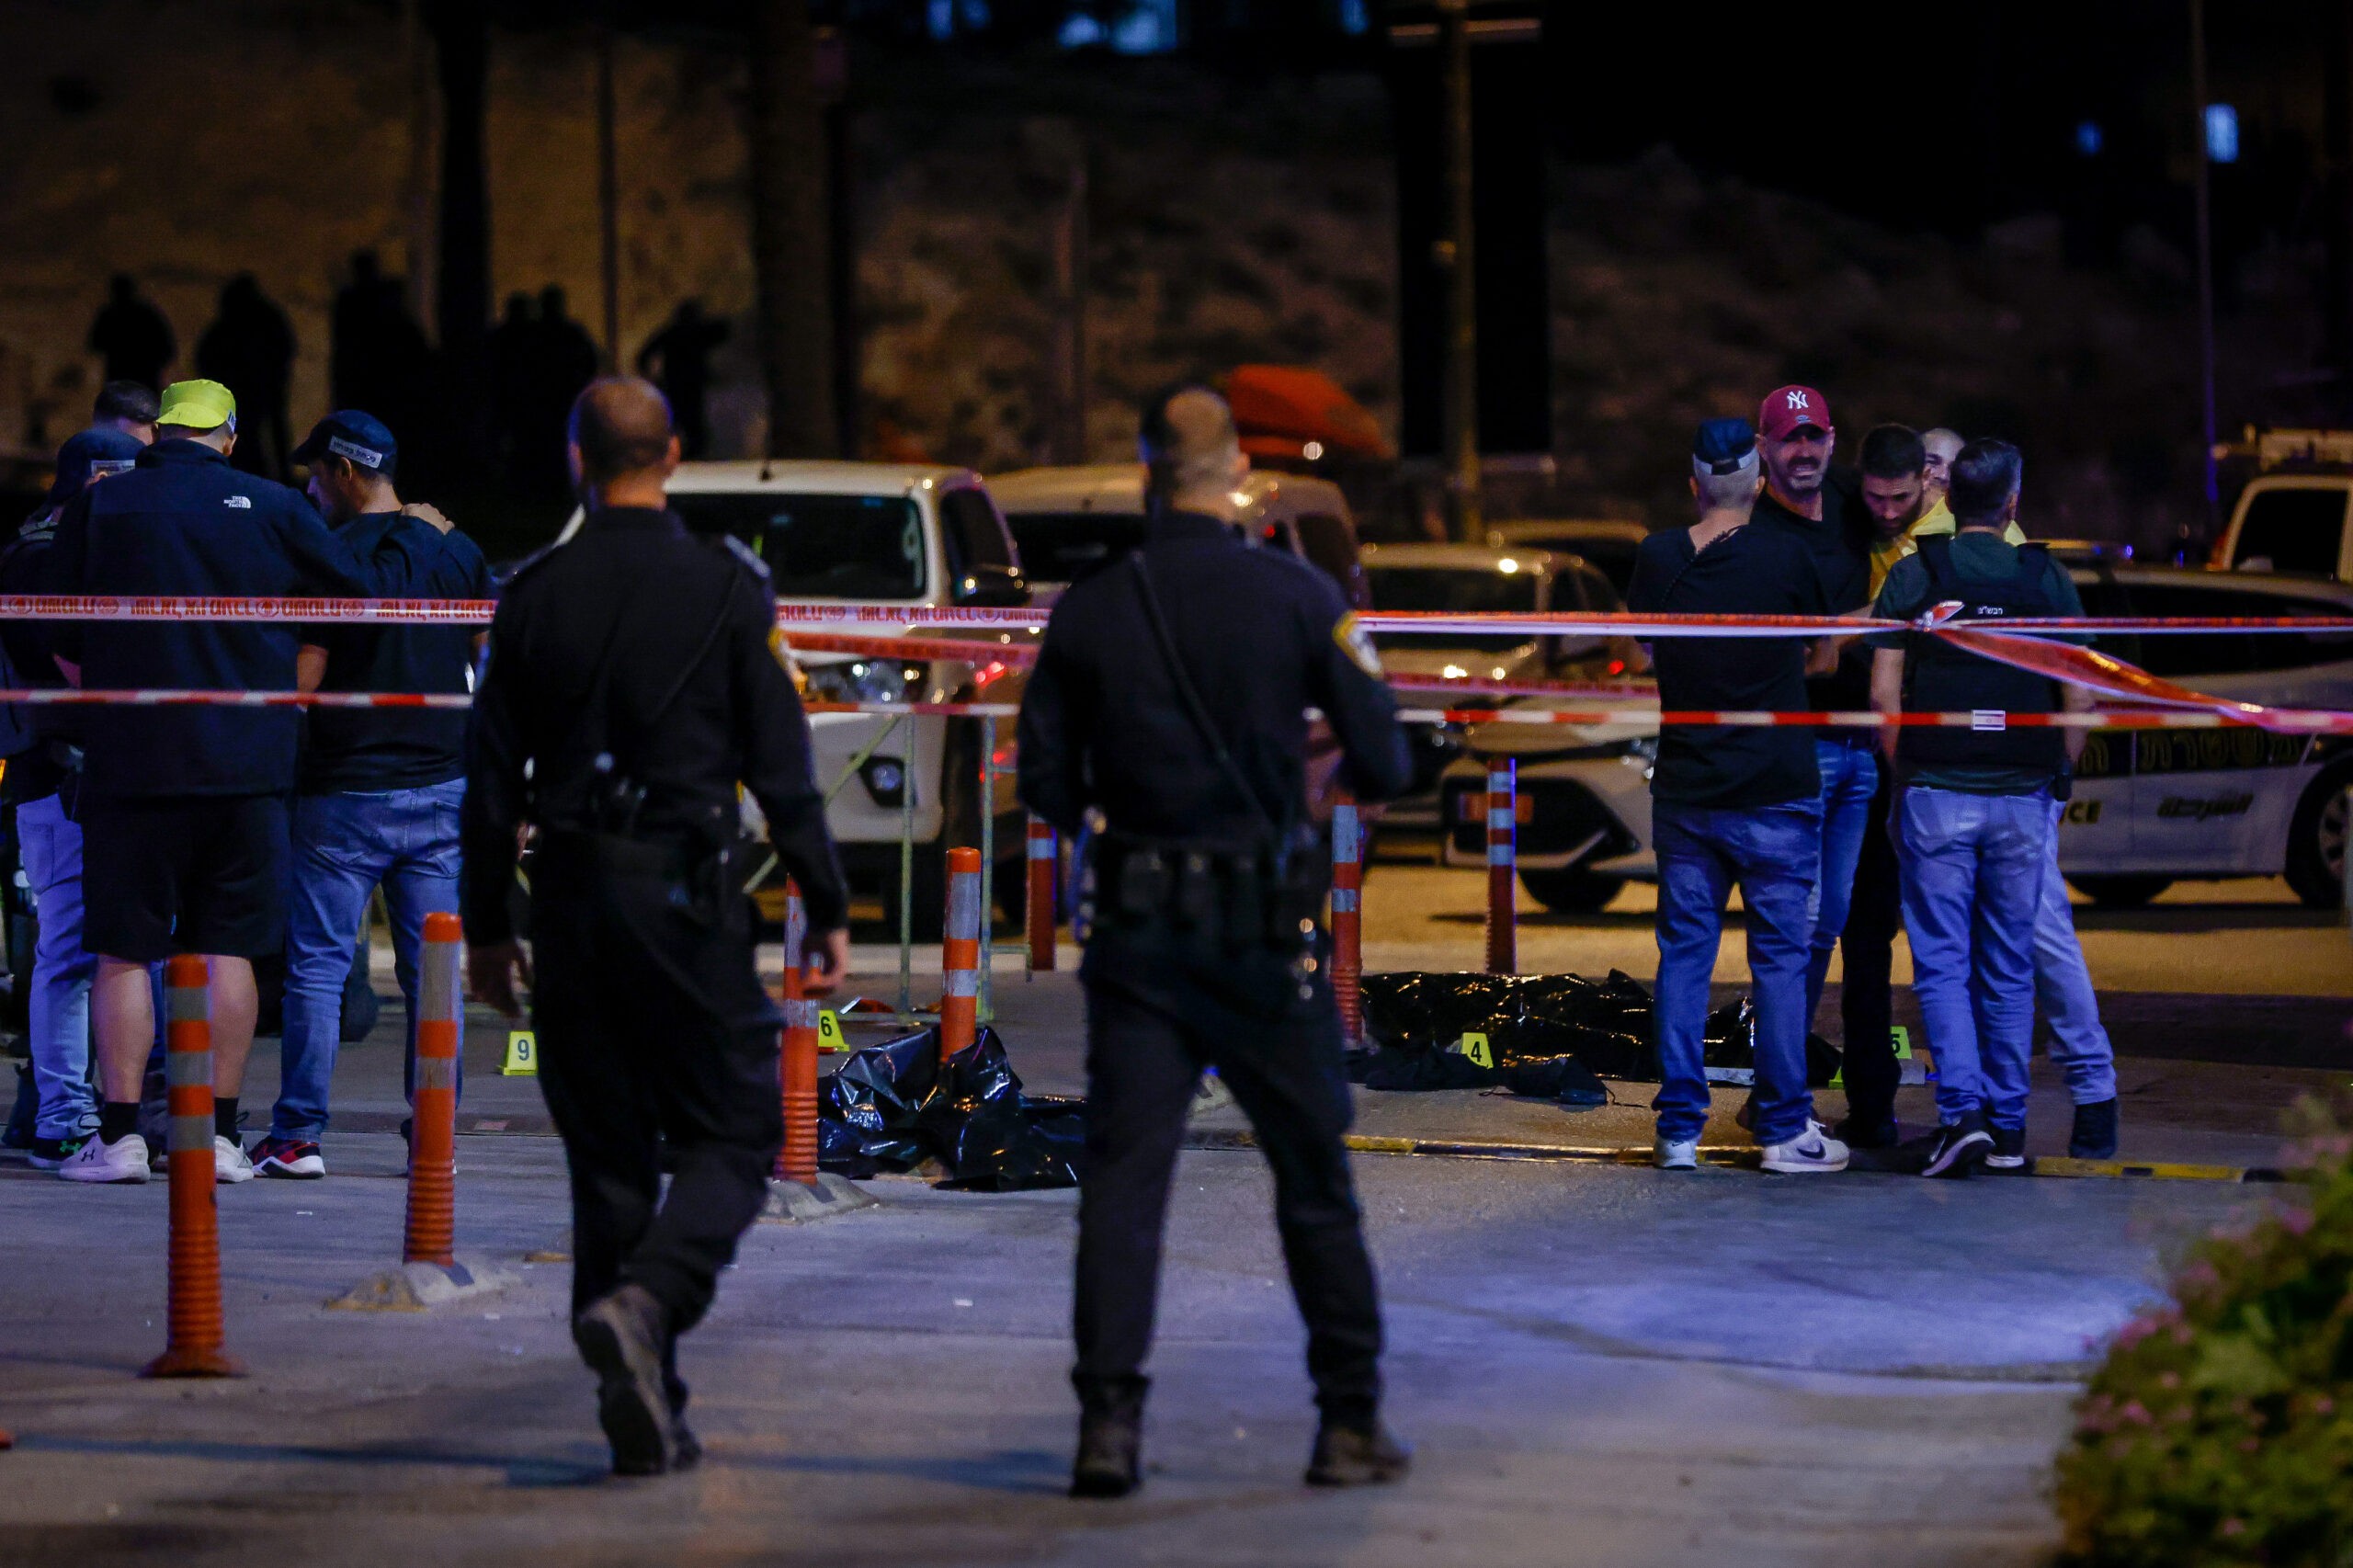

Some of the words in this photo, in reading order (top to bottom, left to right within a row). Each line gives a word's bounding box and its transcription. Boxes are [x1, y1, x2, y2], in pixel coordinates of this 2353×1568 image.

[1787, 390, 1809, 410] NY
[35, 597, 96, 615] משטרת
[131, 598, 183, 619] ישראל
[185, 597, 206, 616] אין
[210, 597, 255, 616] מעבר
[282, 600, 341, 618] משטרת
[376, 601, 427, 621] ישראל
[429, 600, 449, 619] אין
[821, 1016, 833, 1037] 6
[517, 1039, 530, 1062] 9
[1471, 1041, 1482, 1062] 4
[1890, 1034, 1901, 1054] 5
